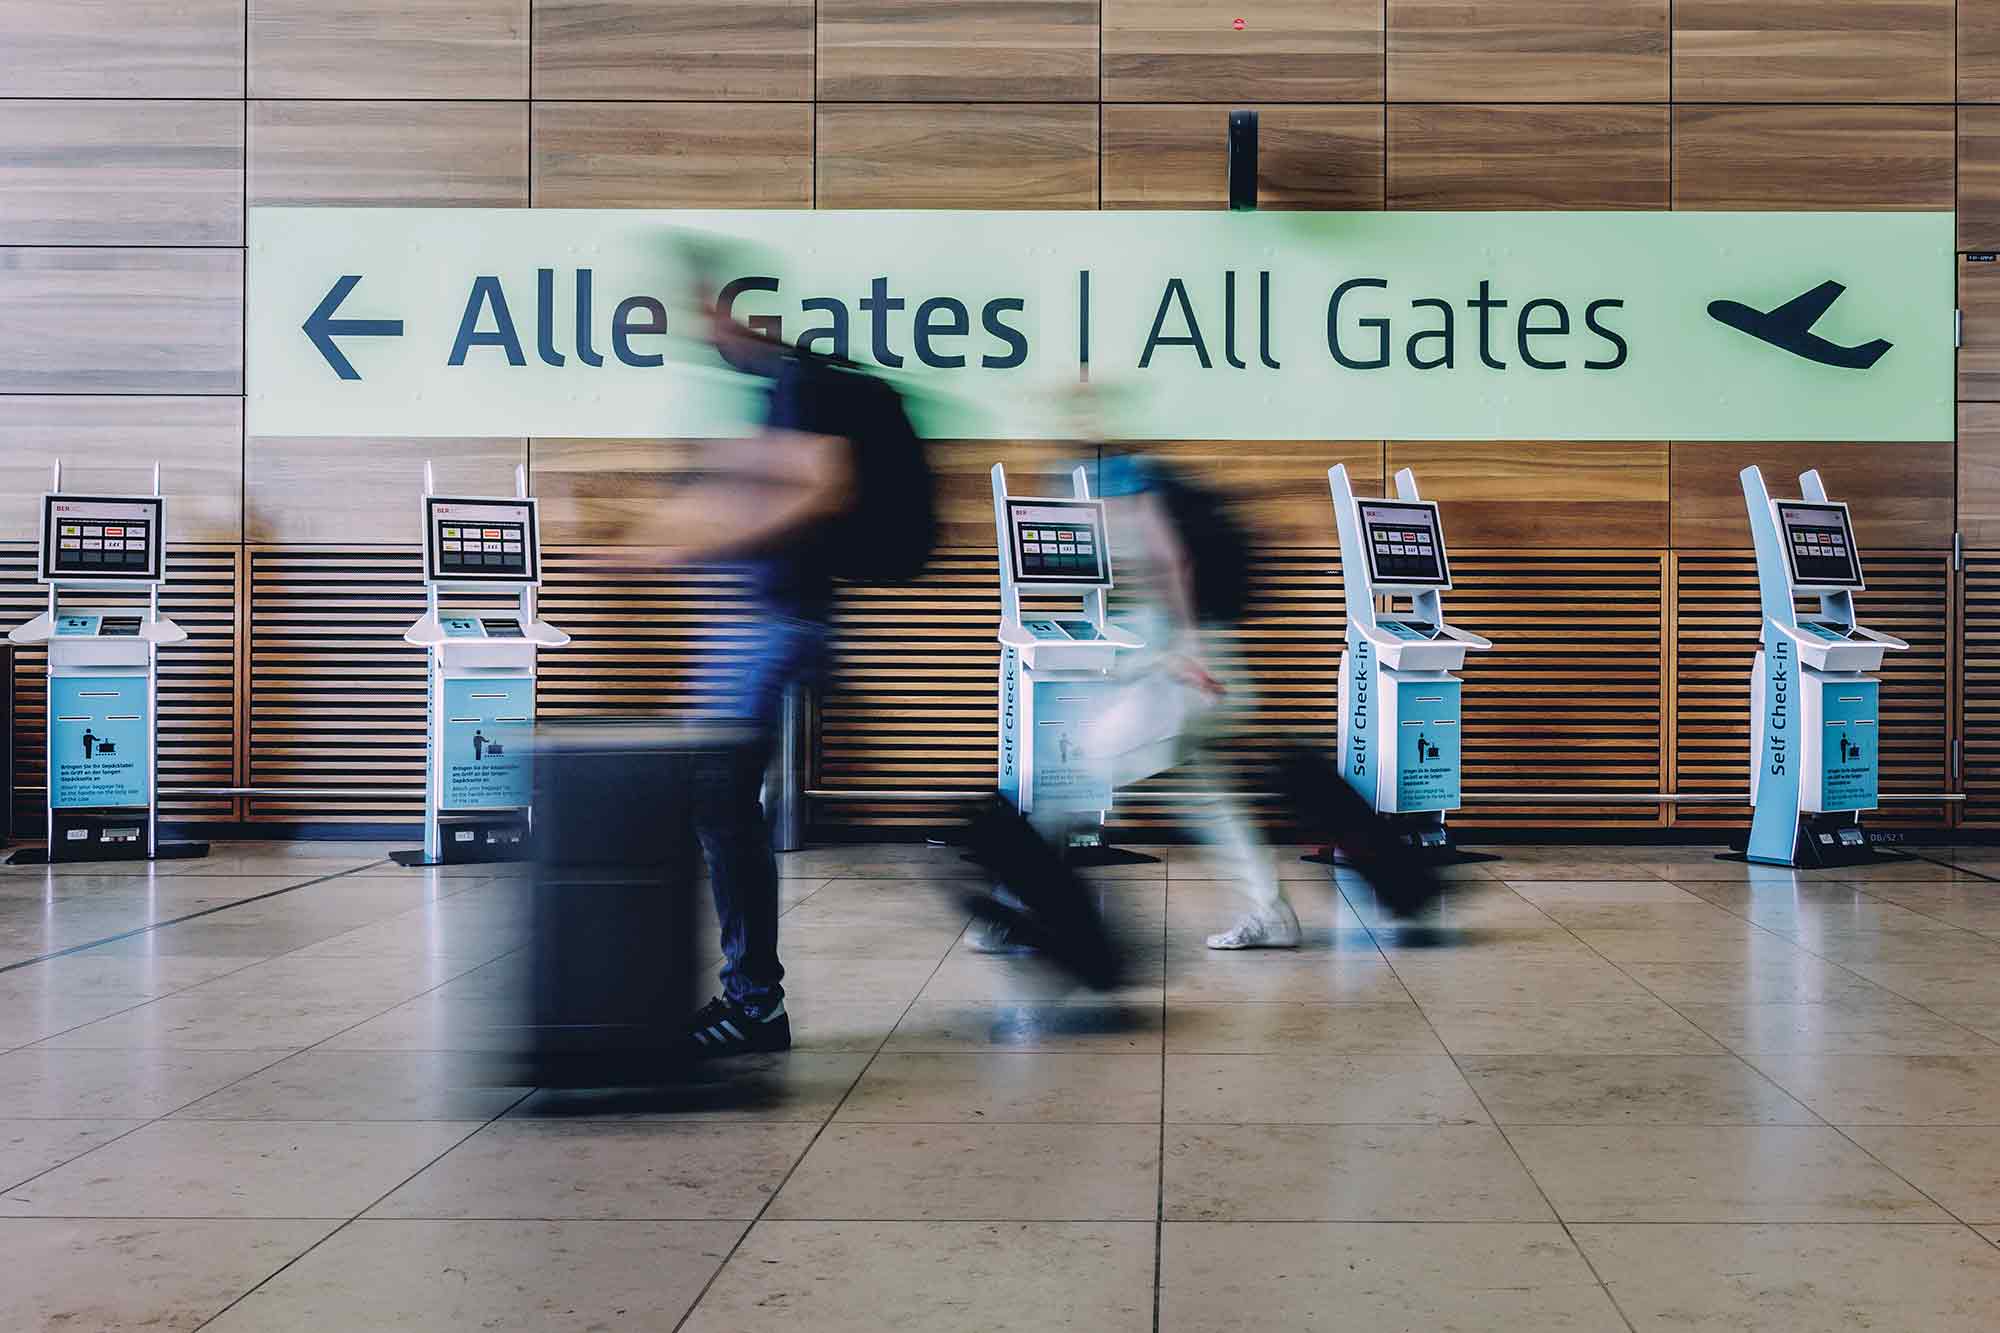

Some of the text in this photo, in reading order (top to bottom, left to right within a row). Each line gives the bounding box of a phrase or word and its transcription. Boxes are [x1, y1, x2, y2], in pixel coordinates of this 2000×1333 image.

[447, 268, 668, 368] Alle
[716, 276, 1029, 369] Gates
[1138, 270, 1281, 369] All
[1327, 278, 1628, 370] Gates
[1005, 735, 1013, 776] Self
[1354, 641, 1368, 776] Self Check-in
[1771, 641, 1788, 776] Self Check-in
